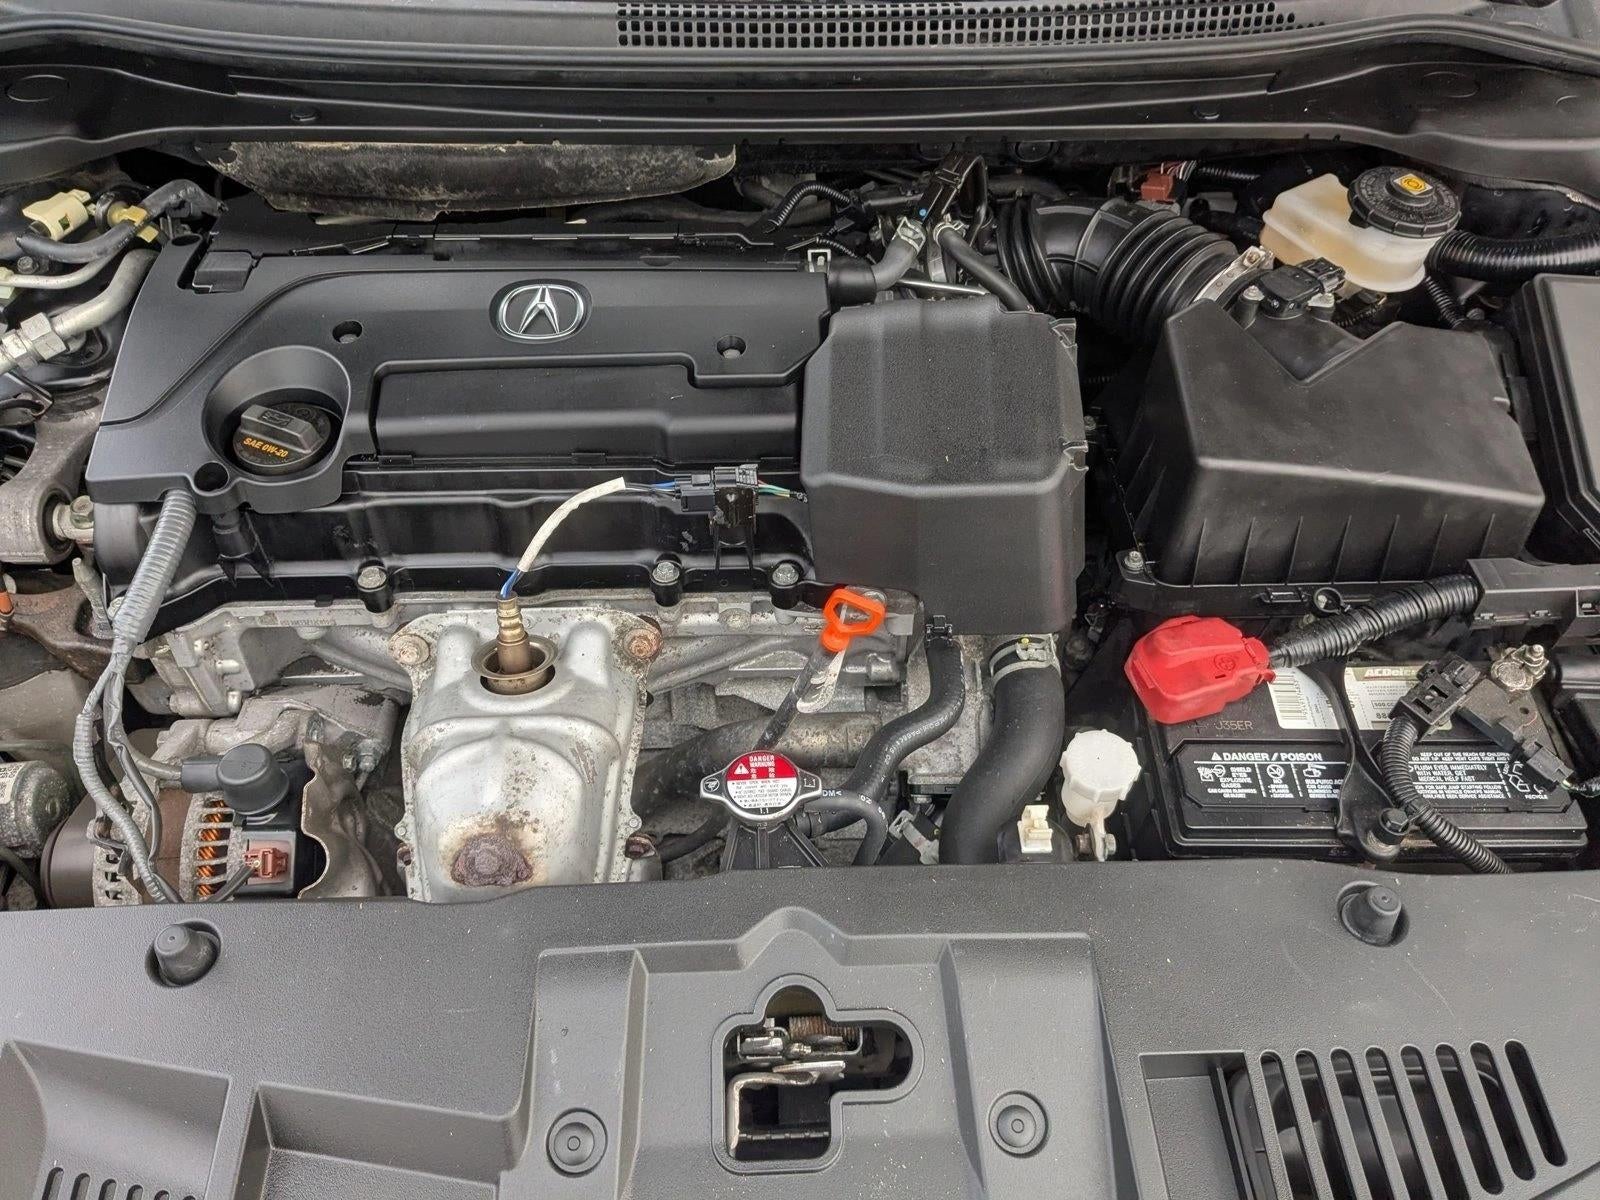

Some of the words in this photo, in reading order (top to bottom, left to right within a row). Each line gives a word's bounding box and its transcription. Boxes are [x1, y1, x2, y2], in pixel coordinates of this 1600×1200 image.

[243, 437, 262, 449] SAE
[261, 444, 288, 458] 0W-20
[1222, 752, 1270, 761] DANGER
[1271, 752, 1278, 761] /
[1280, 752, 1322, 761] POISON
